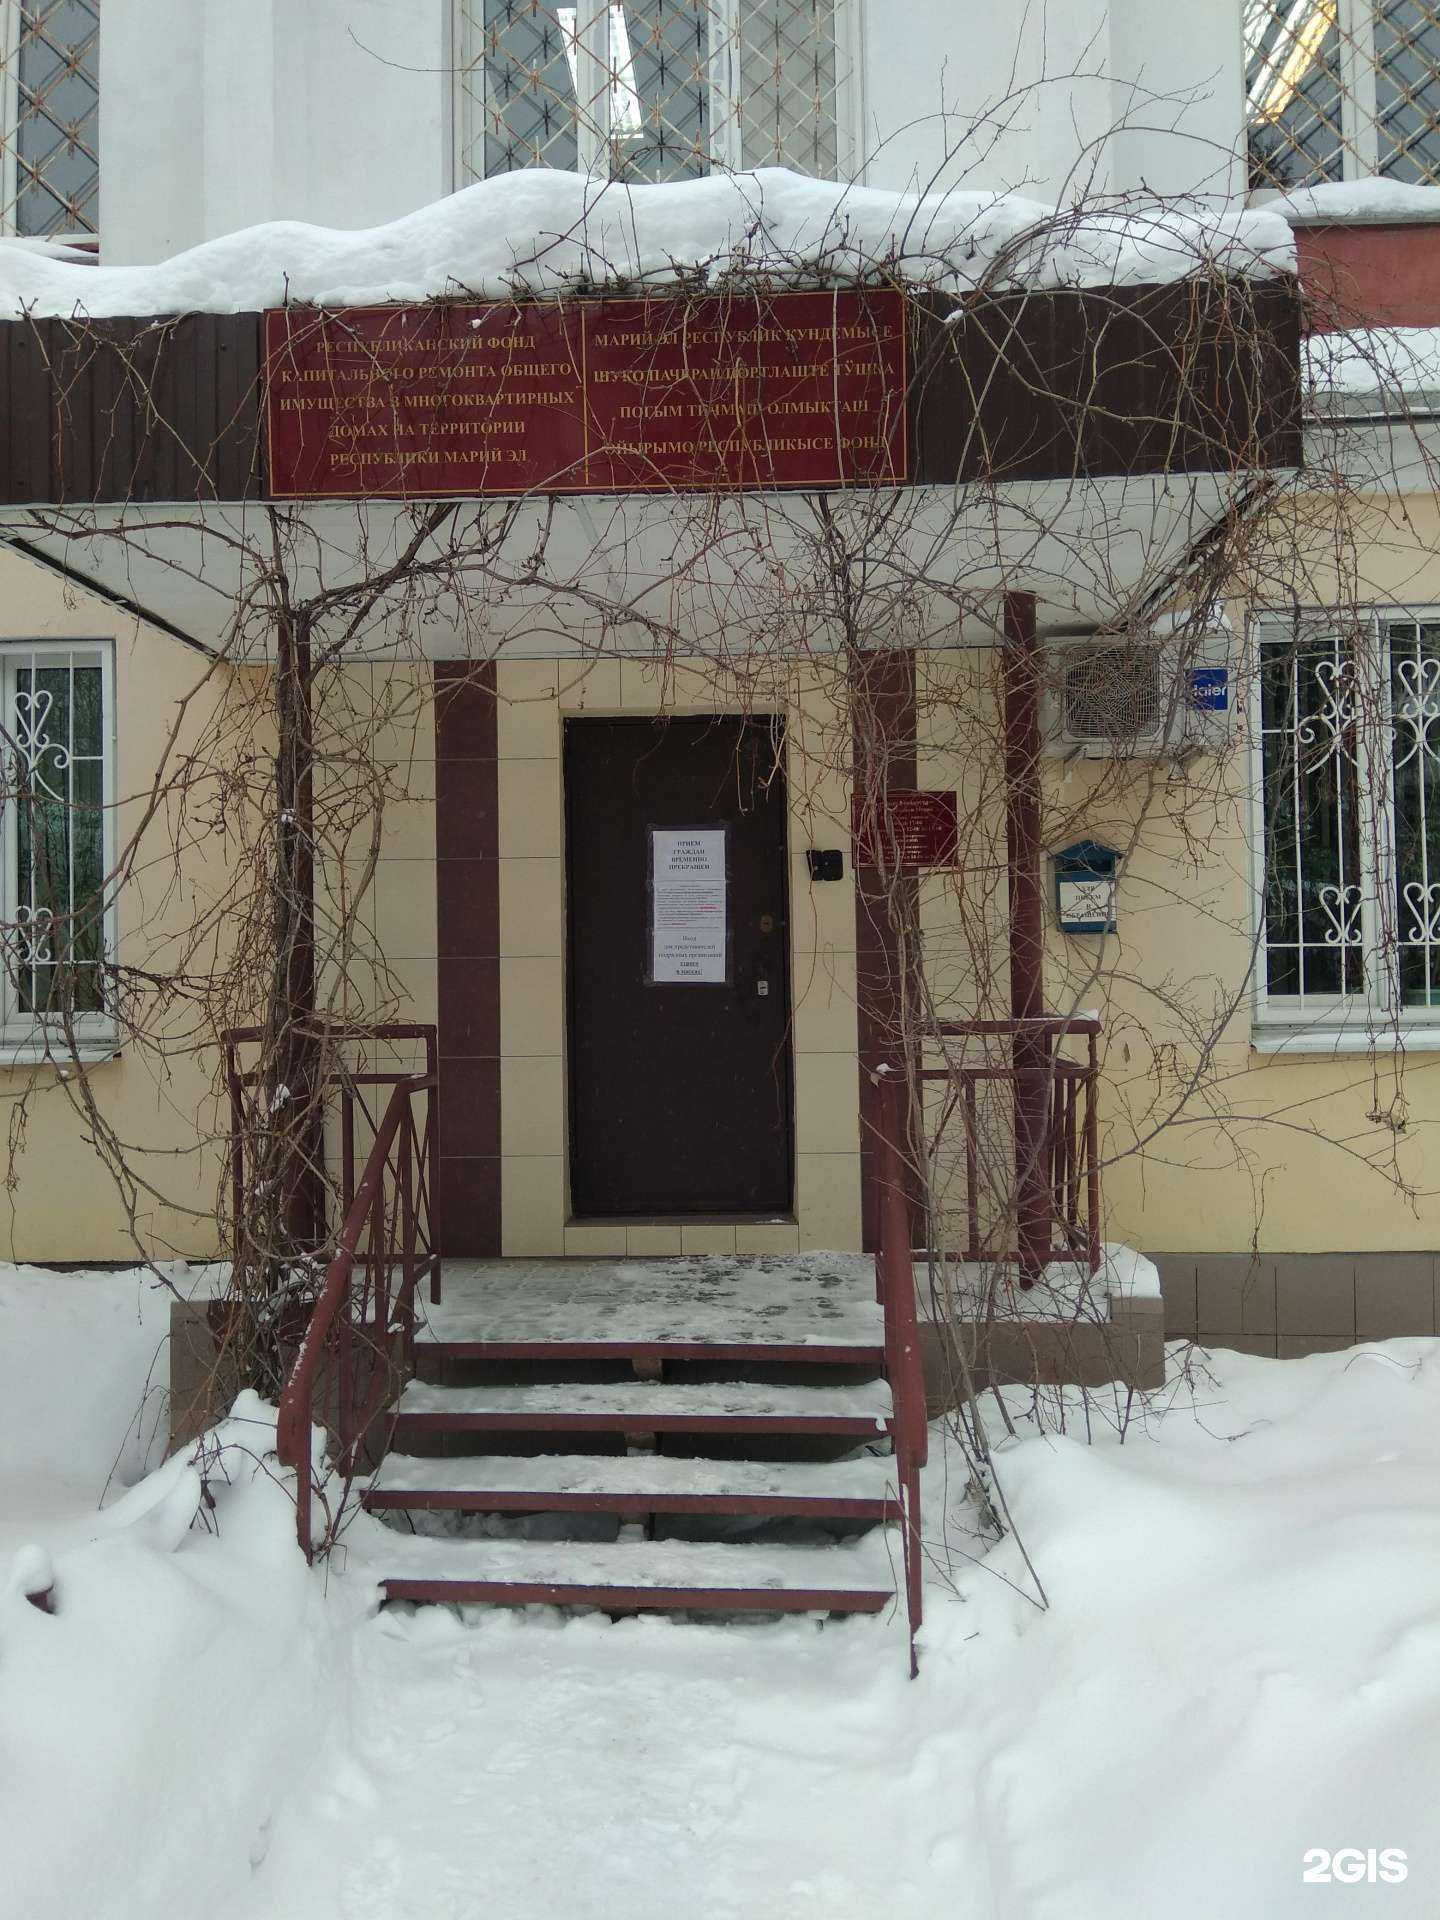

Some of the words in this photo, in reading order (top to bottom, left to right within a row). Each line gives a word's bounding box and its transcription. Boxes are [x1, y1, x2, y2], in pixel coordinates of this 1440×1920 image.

[487, 336, 536, 350] ФОНД
[594, 331, 654, 346] МАРИЙ
[282, 367, 414, 382] КАПИТАЛЬНГО
[419, 365, 496, 380] РЕМОНТА
[501, 363, 571, 378] ОБЩЕГО
[280, 396, 385, 411] ИМУЩЕСТВА
[404, 391, 576, 408] МНОГОКВАРТИРНЫХ
[329, 423, 389, 438] ДОМАХ
[419, 421, 526, 436] ТЕРРИТОРИИ
[330, 451, 439, 466] РЕСПУБЛИКИ
[443, 447, 502, 463] МАРИЙ
[506, 449, 528, 462] ЭЛ
